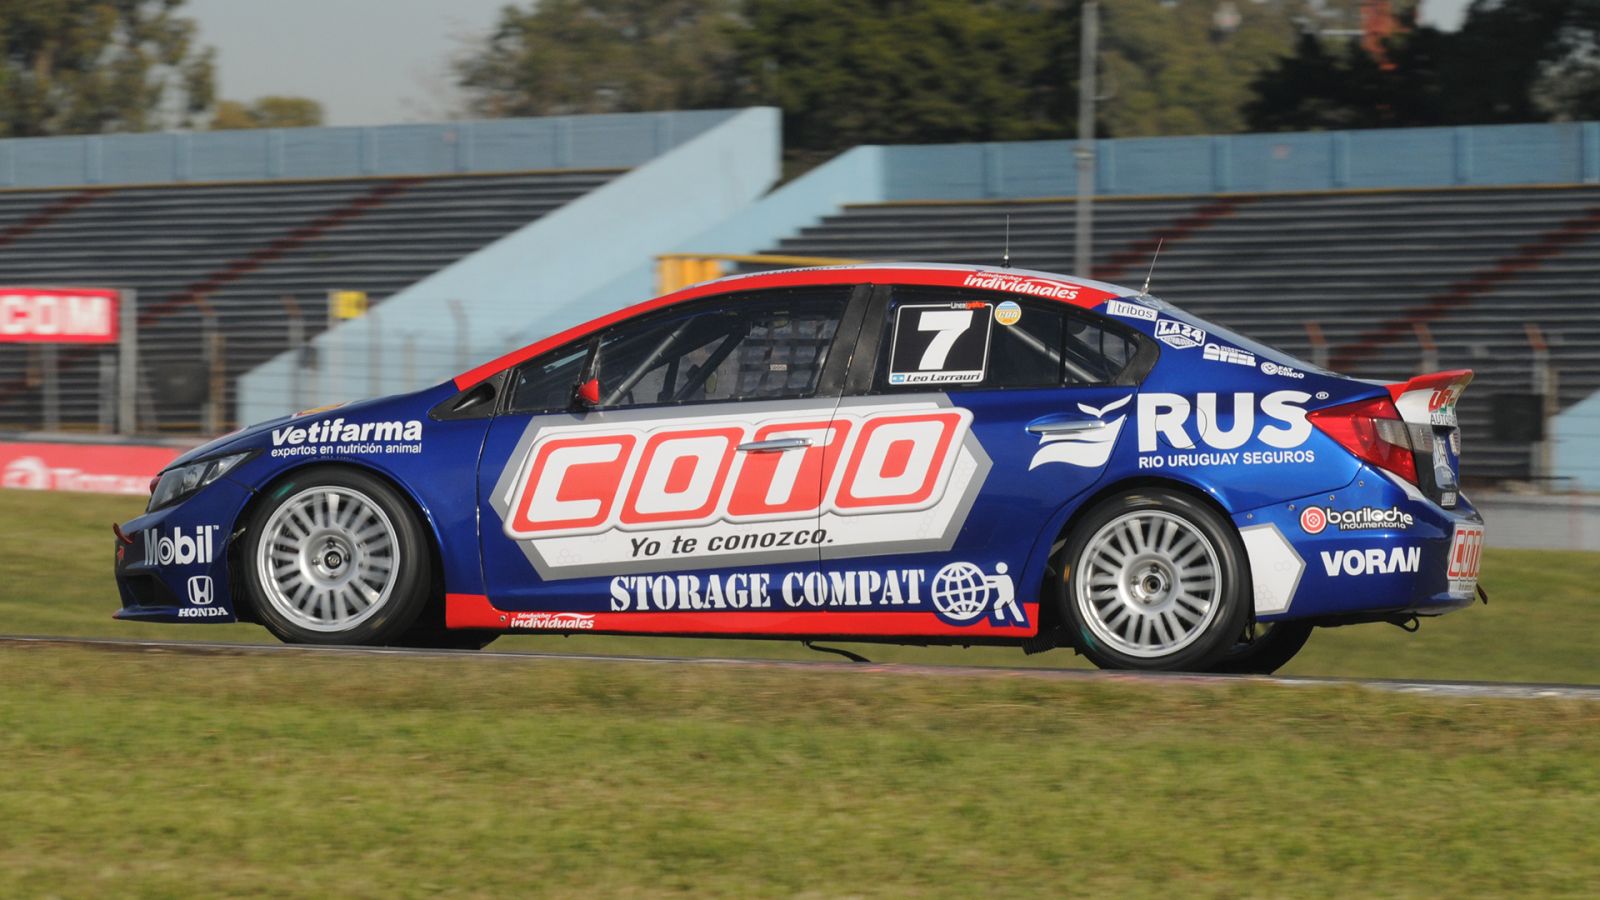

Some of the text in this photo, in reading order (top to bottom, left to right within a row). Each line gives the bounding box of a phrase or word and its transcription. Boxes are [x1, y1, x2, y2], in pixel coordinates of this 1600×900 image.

[964, 274, 1079, 299] individuales
[1116, 303, 1153, 319] tribos
[918, 311, 974, 370] 7
[906, 372, 981, 382] Leo Larrauri
[272, 418, 423, 446] Vetifarma
[1137, 390, 1313, 452] RUS
[271, 444, 317, 458] expertos
[320, 446, 333, 454] en
[336, 443, 384, 454] nutrición
[386, 442, 422, 454] animal
[1138, 450, 1315, 469] RIO URUGUAY SEGUROS
[511, 412, 962, 532] COTO
[1327, 507, 1414, 525] bariloche
[144, 525, 213, 566] Mobil
[630, 528, 834, 557] Yo te conozco.
[1448, 529, 1482, 577] COT
[1320, 547, 1421, 577] VORAN
[609, 569, 925, 612] STORAGE COMPAT
[178, 606, 228, 617] HONDA
[511, 617, 595, 629] individuales
